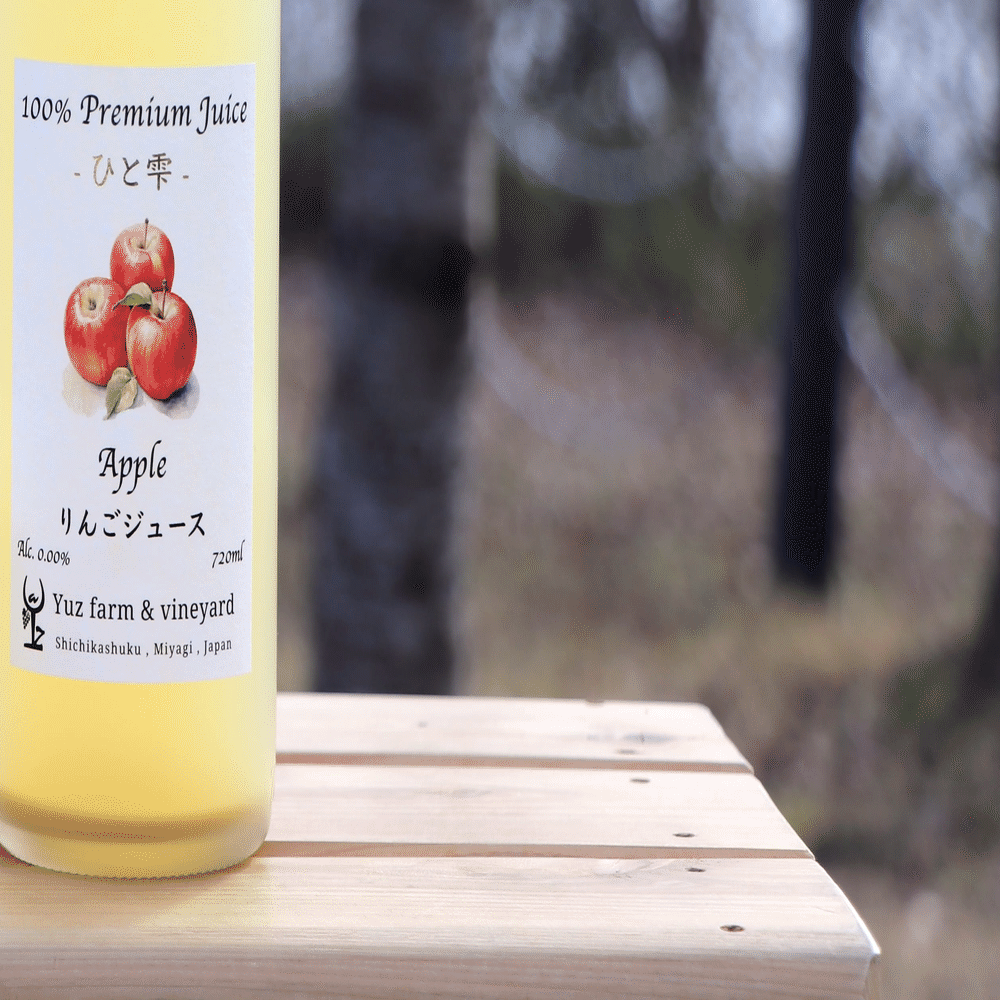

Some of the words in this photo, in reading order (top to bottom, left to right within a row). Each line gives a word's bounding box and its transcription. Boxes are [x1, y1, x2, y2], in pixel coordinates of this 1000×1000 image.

[21, 94, 72, 125] 100%
[79, 93, 193, 128] Premium
[195, 93, 248, 136] Juice
[98, 439, 167, 496] Apple
[61, 507, 206, 539] りんごジュース
[16, 536, 36, 561] Alc.
[37, 547, 71, 567] 0.00%
[210, 539, 246, 569] 720ml
[52, 592, 84, 618] Yuz
[89, 595, 135, 621] farm
[140, 599, 155, 622] &
[160, 592, 235, 626] vineyard
[55, 636, 142, 656] Shichikashuku
[153, 642, 193, 659] Miyagi
[203, 639, 232, 657] Japan
